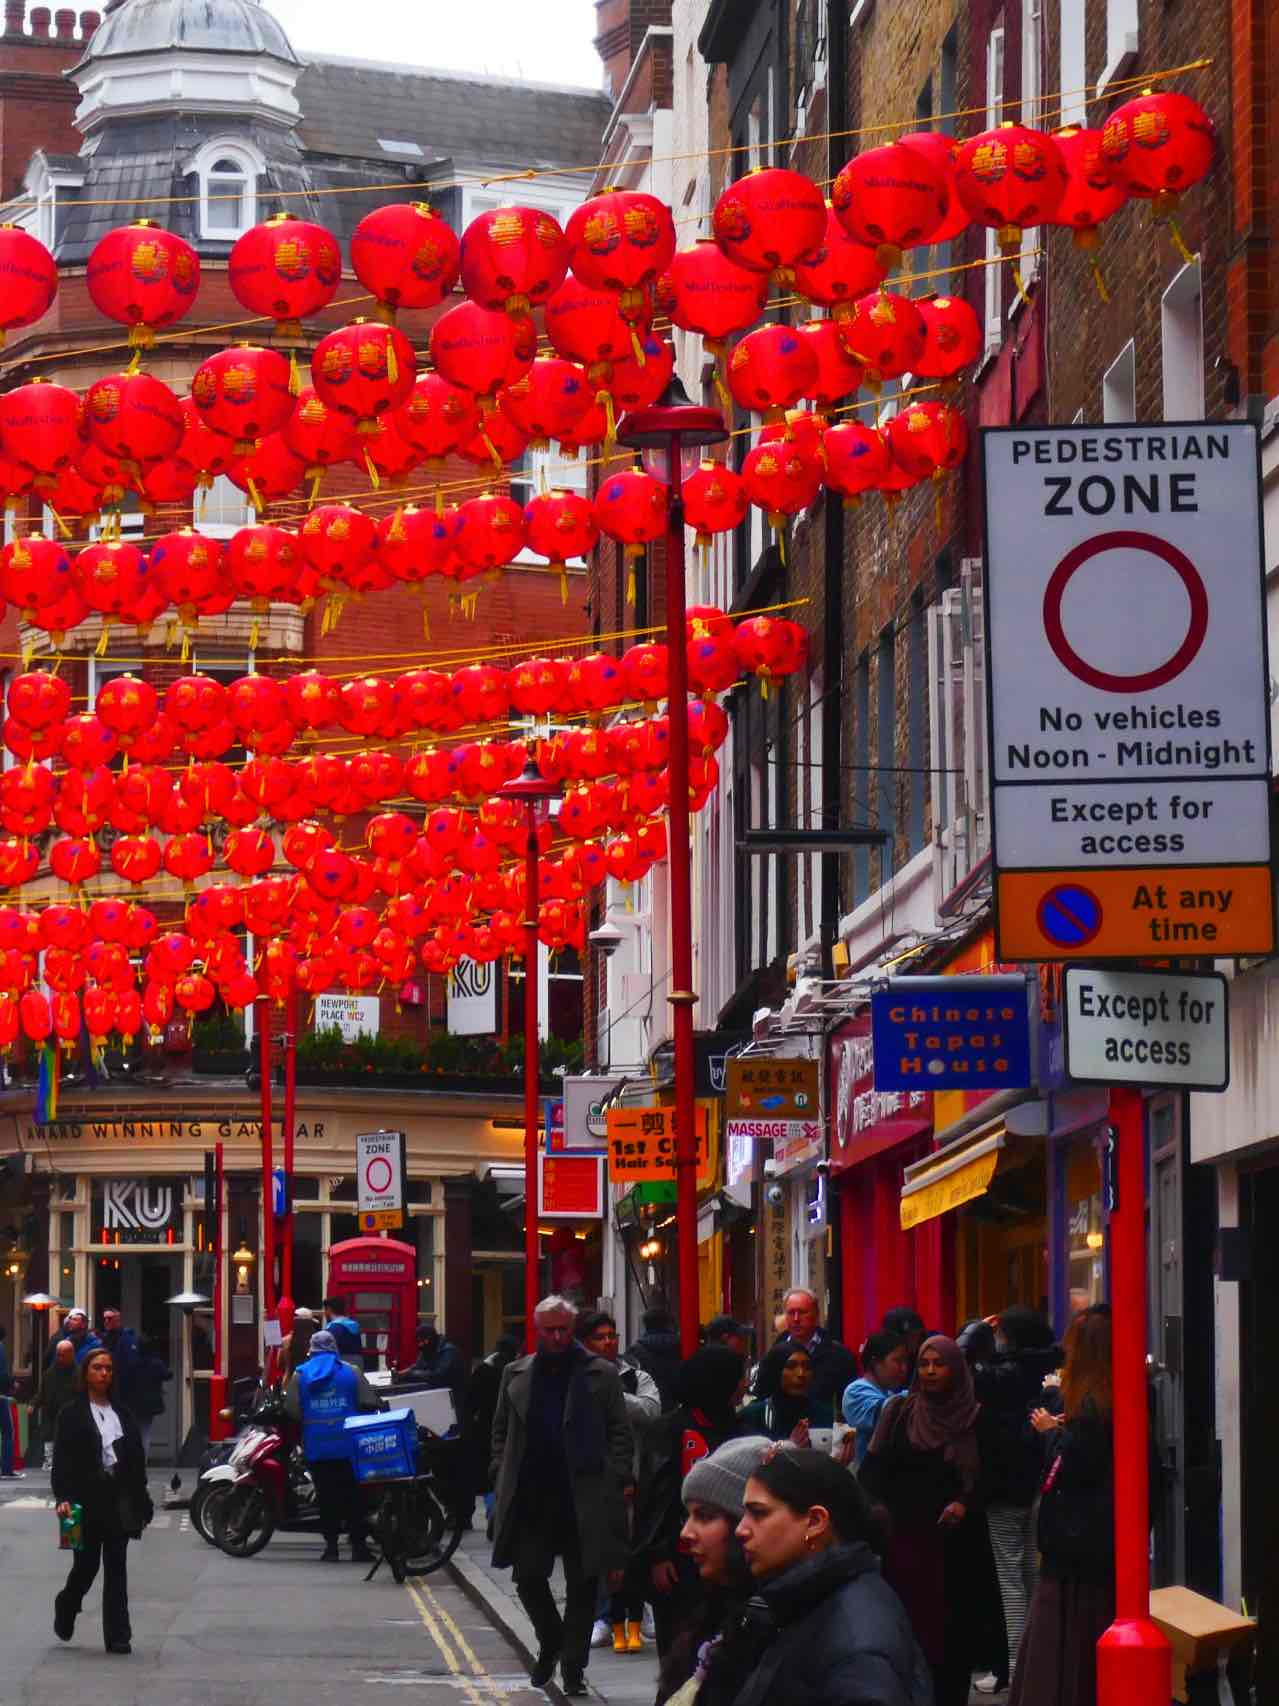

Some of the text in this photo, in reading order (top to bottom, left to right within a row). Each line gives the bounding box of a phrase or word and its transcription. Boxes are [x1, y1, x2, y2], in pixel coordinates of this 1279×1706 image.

[1013, 434, 1230, 464] PEDESTRIAN
[1044, 473, 1198, 516] ZONE
[1040, 705, 1221, 731] No vehicles
[1008, 746, 1089, 768] Noon
[1117, 740, 1255, 768] Midnight
[1051, 797, 1213, 825] Except for
[1081, 832, 1184, 854] access
[1132, 885, 1232, 913] At any
[1150, 920, 1217, 941] time
[453, 960, 490, 998] KU
[320, 1000, 360, 1010] NEWPORT
[320, 1010, 364, 1021] PLACE WC2
[889, 1007, 1014, 1023] Chinese
[1079, 985, 1214, 1027] Except for
[905, 1032, 1001, 1051] Tapas
[1105, 1037, 1191, 1066] access
[900, 1057, 1009, 1074] House
[93, 1121, 202, 1138] WINNING
[218, 1122, 266, 1138] GAY
[280, 1123, 325, 1139] AR
[728, 1122, 788, 1137] MASSAGE
[365, 1143, 391, 1154] ZONE
[613, 1136, 702, 1155] 1st CT
[655, 1156, 701, 1168] San
[103, 1182, 171, 1228] KU
